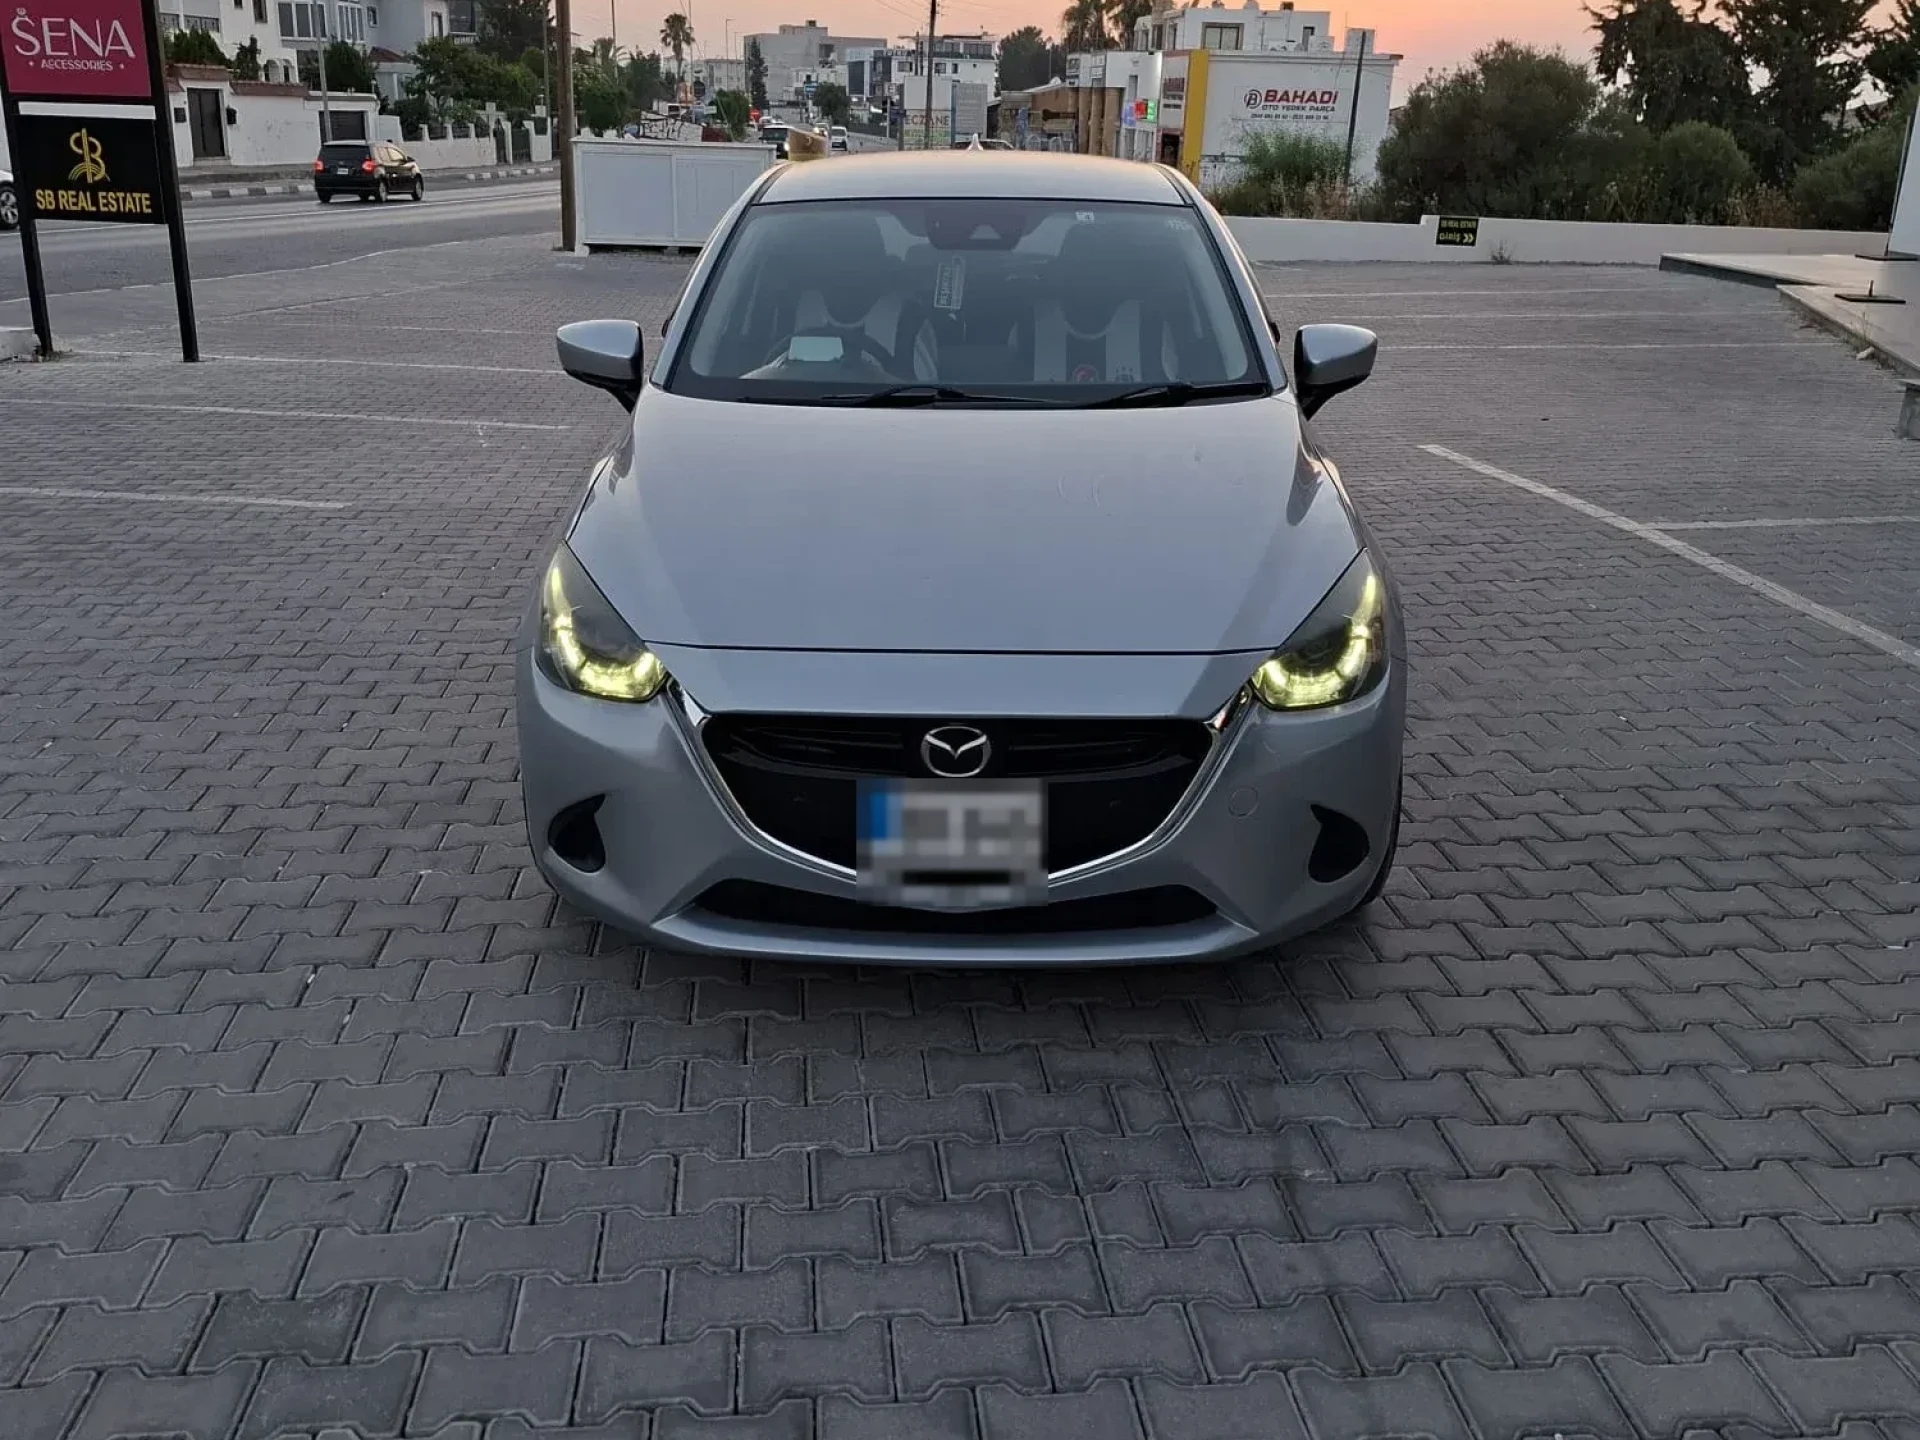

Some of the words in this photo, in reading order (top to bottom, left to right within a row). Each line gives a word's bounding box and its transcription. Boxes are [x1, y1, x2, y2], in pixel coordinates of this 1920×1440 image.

[41, 59, 113, 71] ACCESSORIES
[1264, 89, 1339, 104] BAHADI
[1262, 103, 1279, 111] OTO
[1281, 104, 1306, 112] YEDEK
[35, 189, 55, 210] SB
[58, 190, 97, 211] REAL
[98, 191, 152, 214] ESTATE
